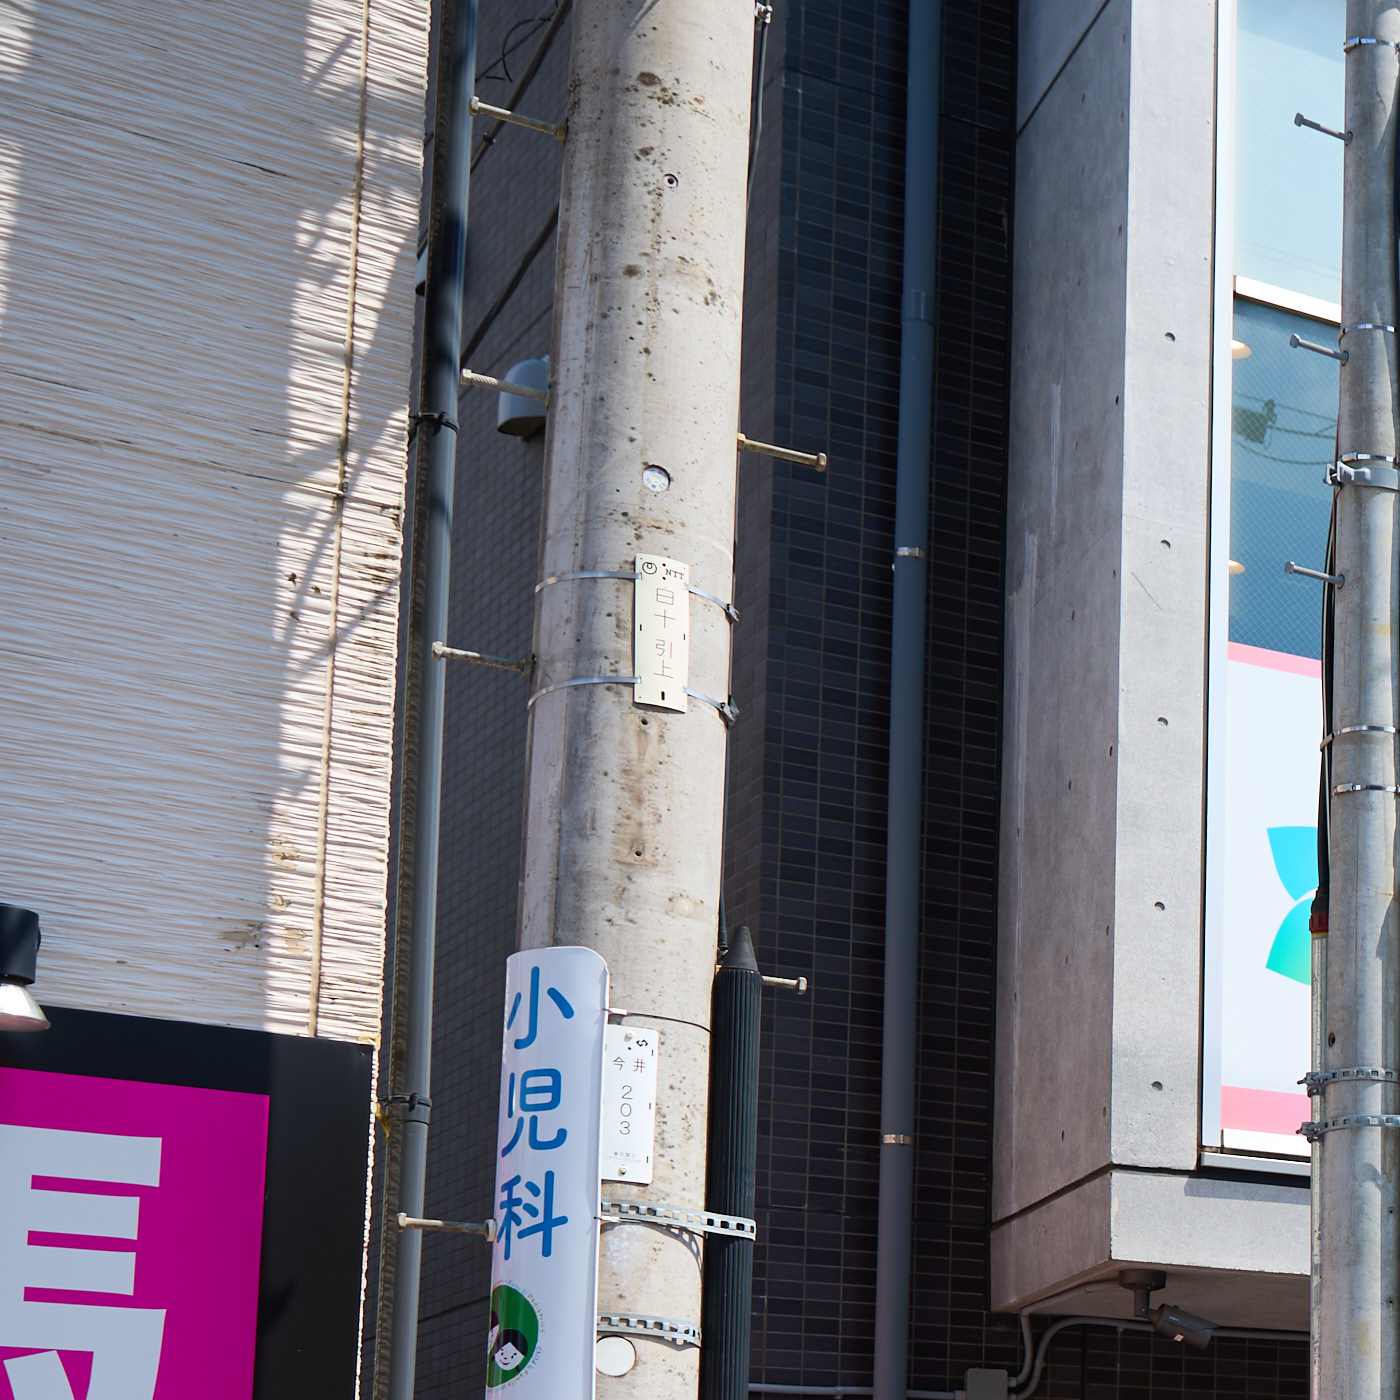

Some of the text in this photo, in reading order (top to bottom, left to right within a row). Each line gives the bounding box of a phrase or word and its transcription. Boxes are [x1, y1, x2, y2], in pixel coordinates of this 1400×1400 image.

[664, 567, 685, 581] NTT
[612, 1056, 647, 1074] 今井
[497, 966, 574, 1261] 小児科
[619, 1084, 634, 1136] 203
